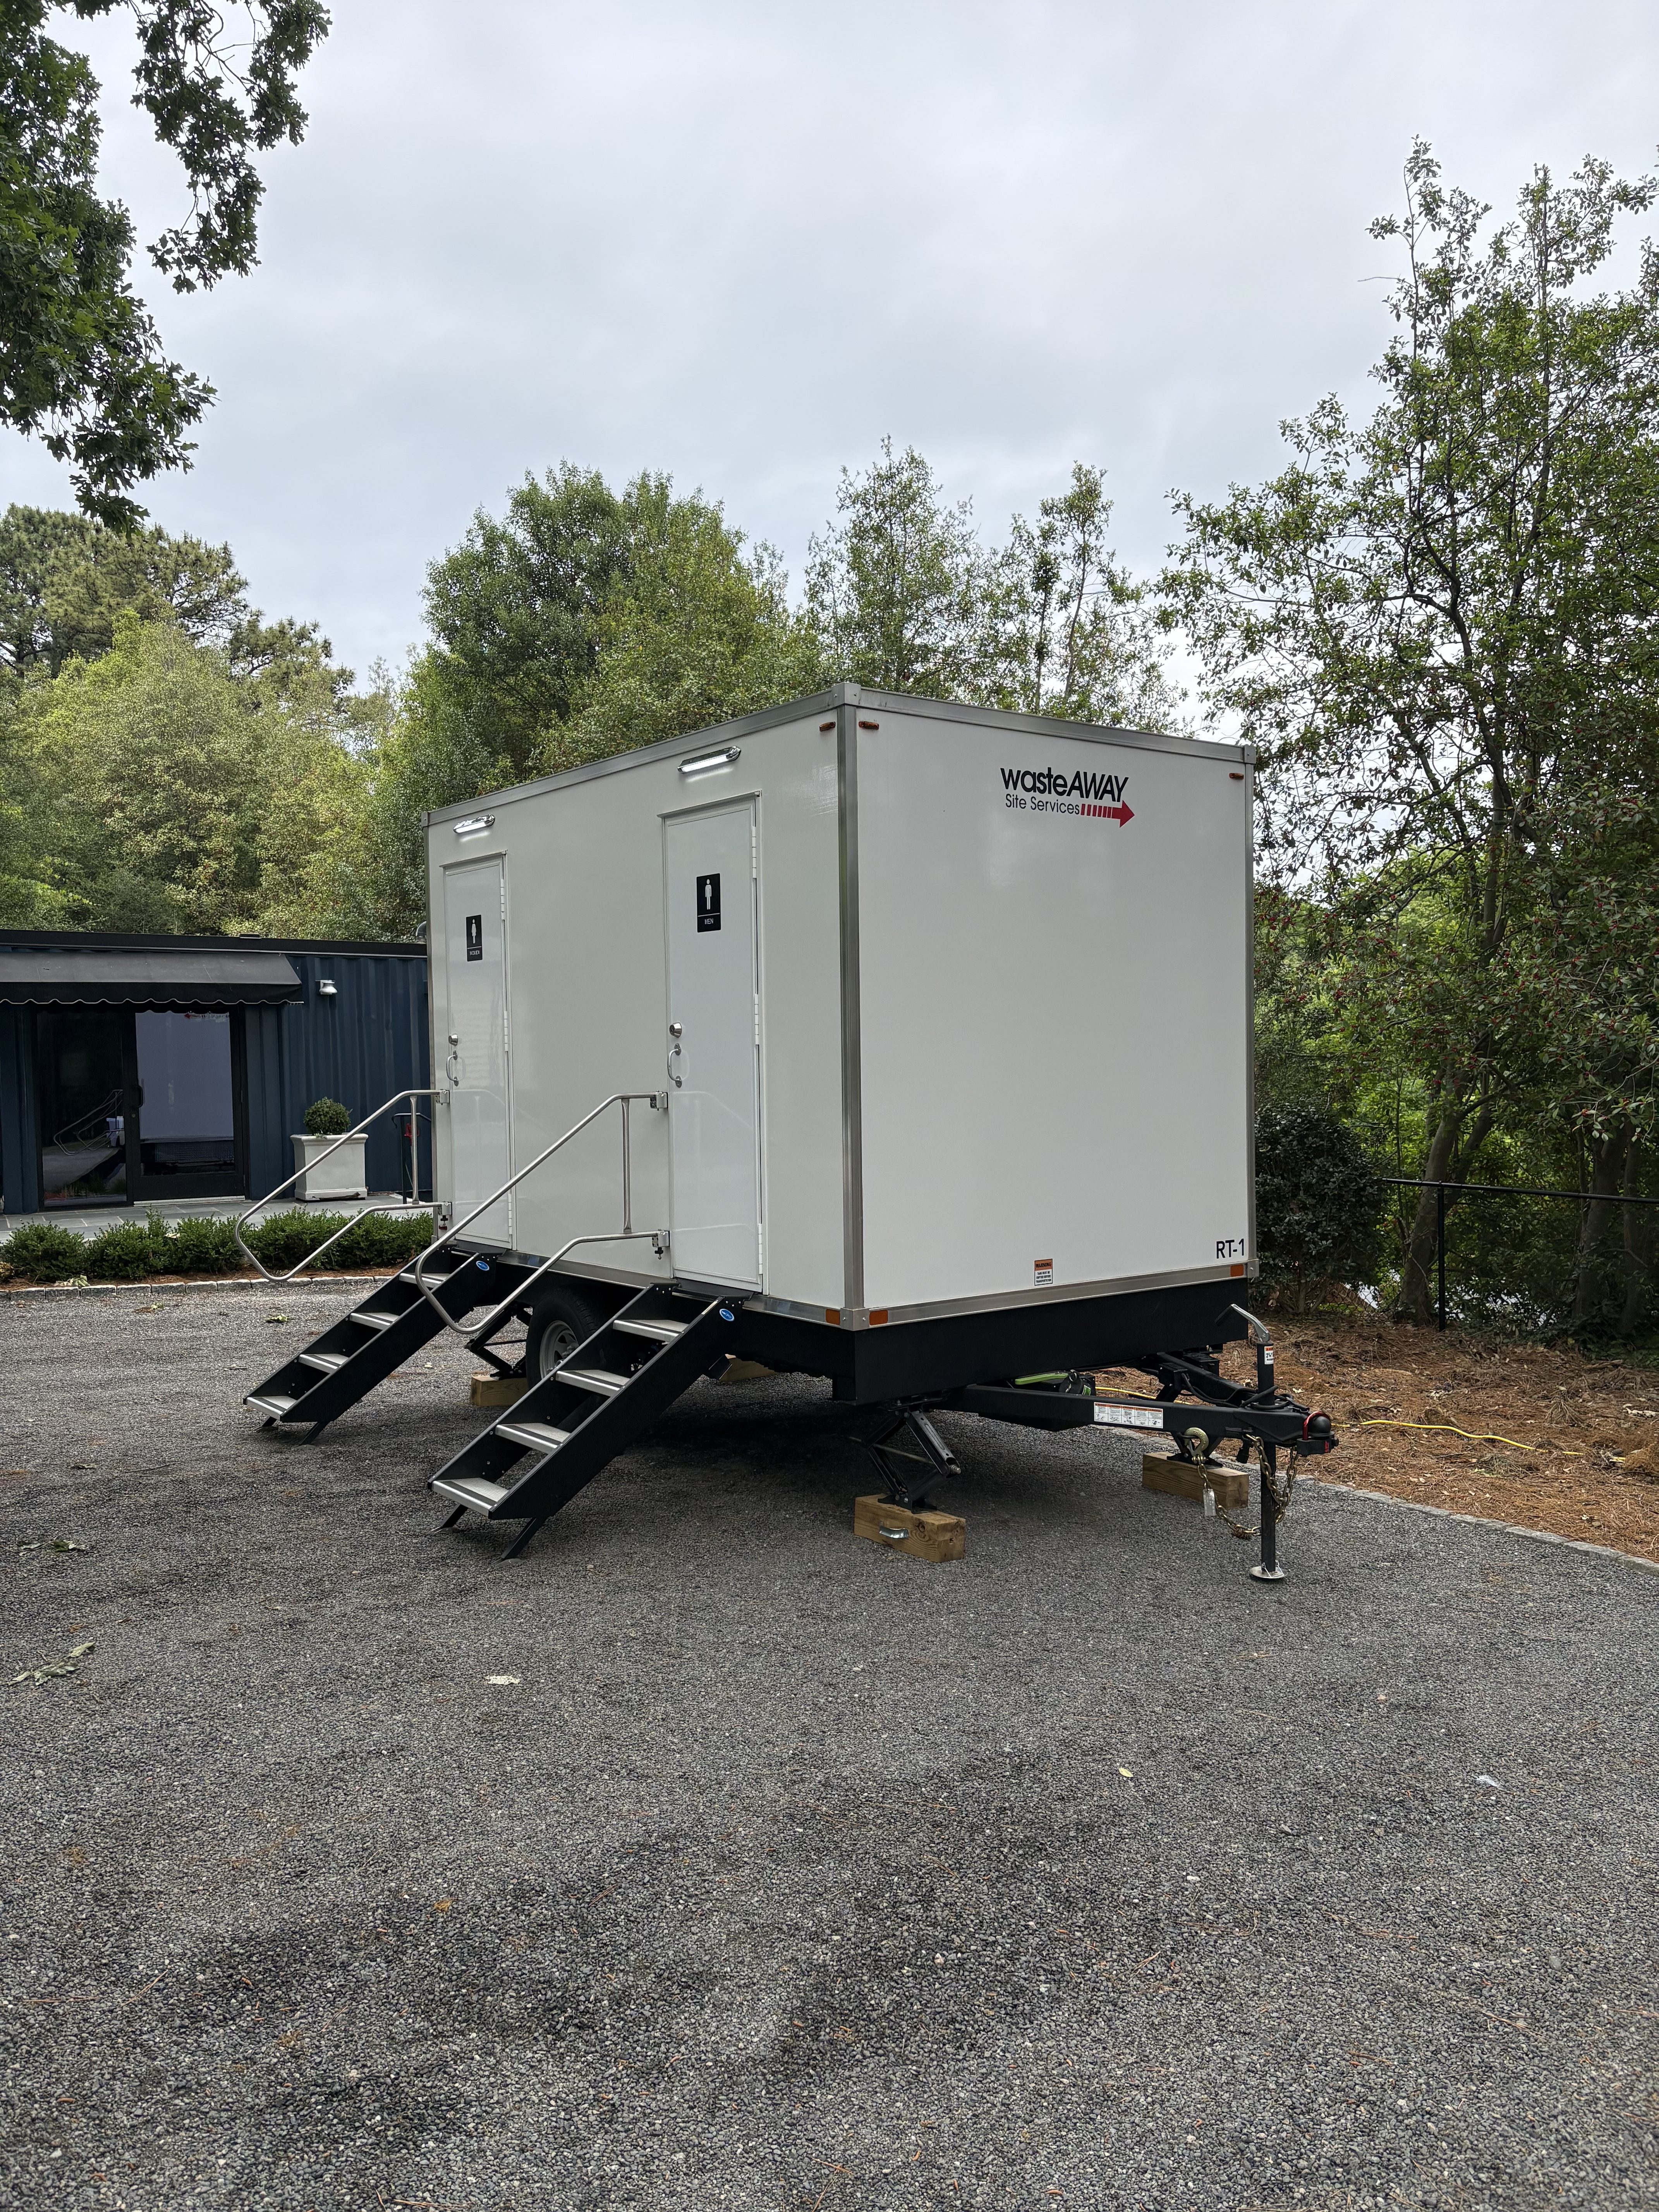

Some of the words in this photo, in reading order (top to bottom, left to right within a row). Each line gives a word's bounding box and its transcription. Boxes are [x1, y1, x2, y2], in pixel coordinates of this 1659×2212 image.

[1000, 767, 1129, 802] wasteAWAY
[1005, 793, 1027, 809] Site
[1030, 796, 1080, 815] Services
[1216, 1238, 1244, 1259] RT-1
